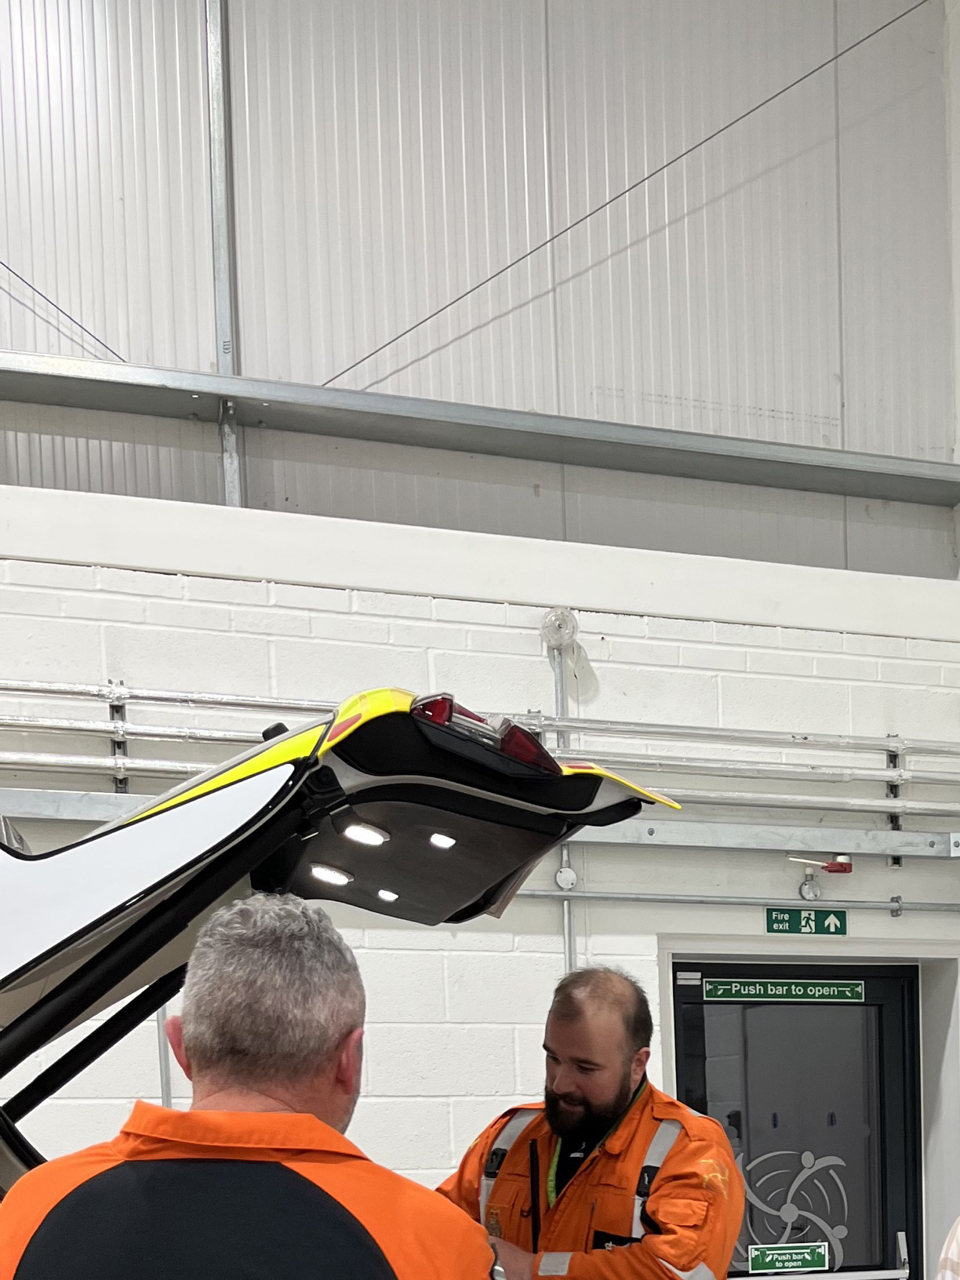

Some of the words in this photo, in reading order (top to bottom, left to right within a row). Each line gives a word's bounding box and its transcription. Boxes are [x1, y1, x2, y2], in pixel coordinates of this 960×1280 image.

[772, 911, 790, 920] Fire
[773, 922, 790, 930] exit
[731, 983, 764, 995] Push
[767, 984, 789, 995] bar
[791, 985, 804, 995] to
[807, 986, 838, 997] open
[784, 1260, 802, 1268] open
